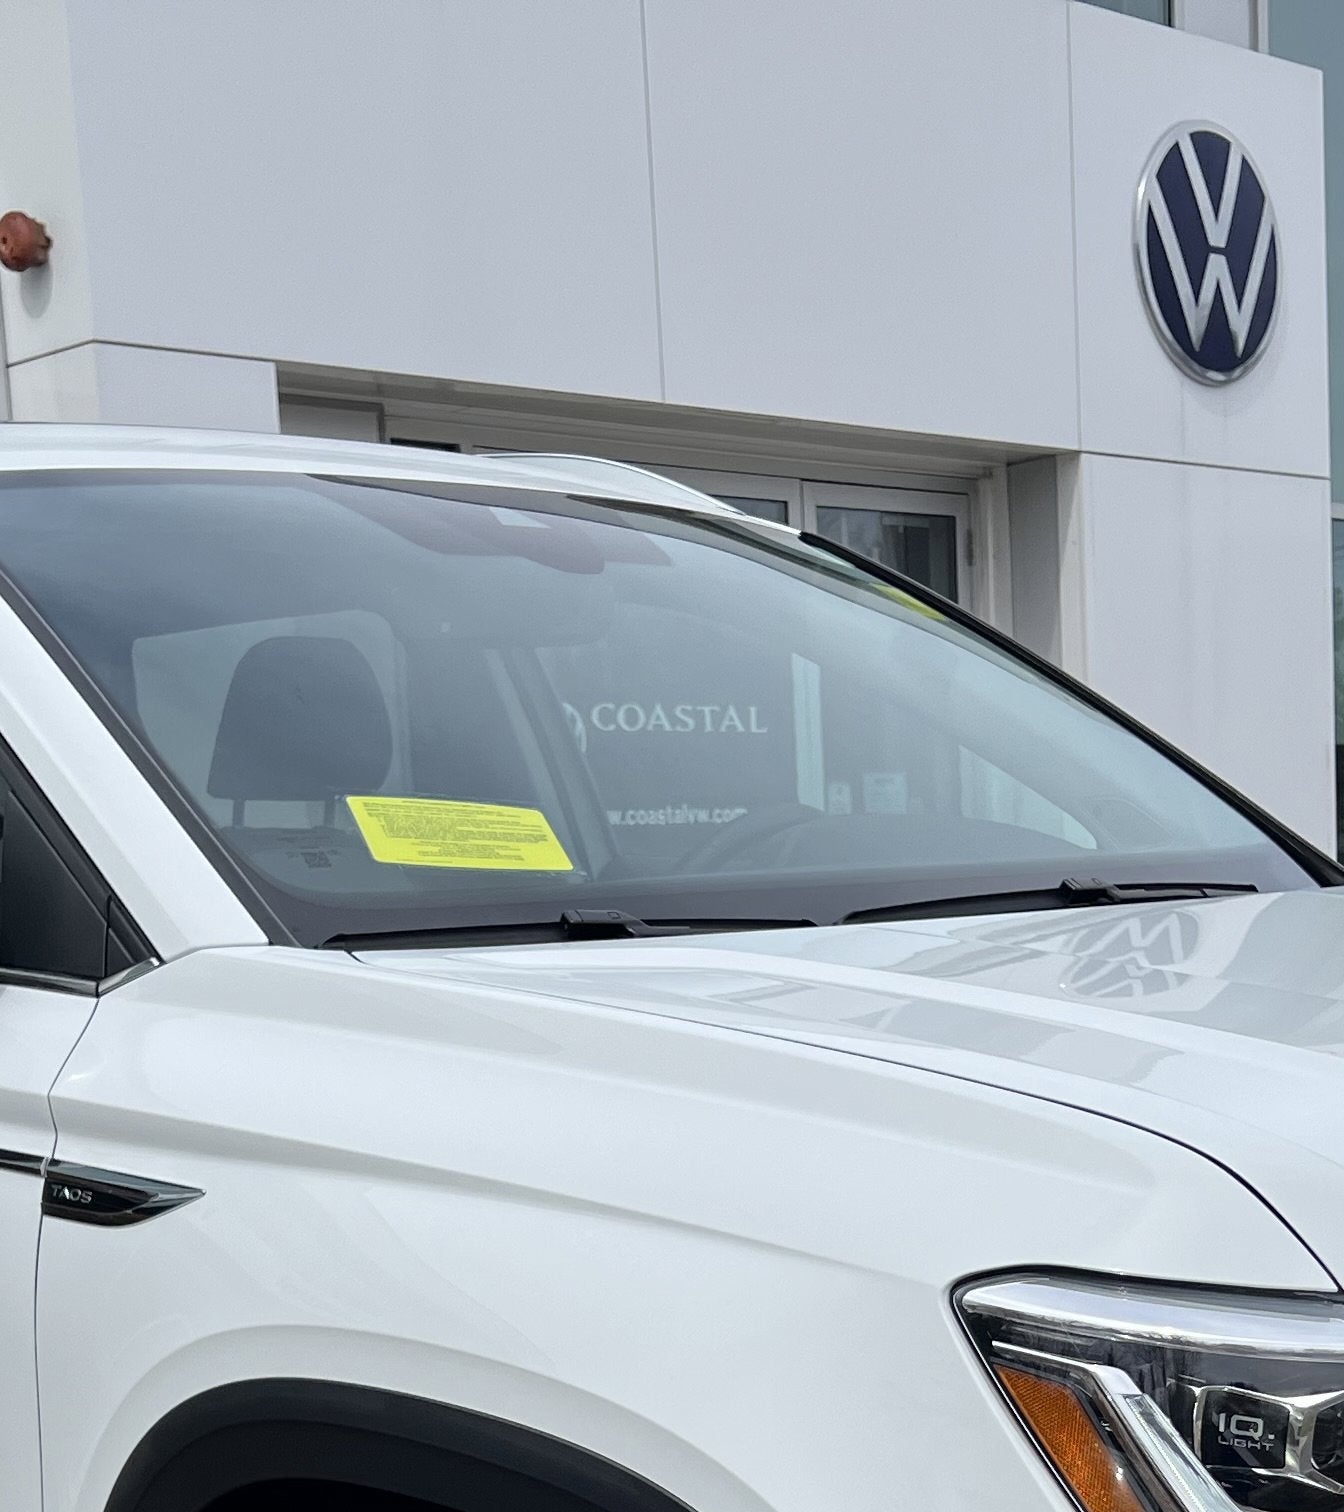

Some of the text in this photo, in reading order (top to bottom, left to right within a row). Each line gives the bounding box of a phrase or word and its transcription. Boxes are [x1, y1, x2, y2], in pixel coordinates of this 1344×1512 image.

[590, 703, 769, 734] COASTAL
[50, 1183, 93, 1205] TAOS
[1217, 1435, 1275, 1452] LIGHT
